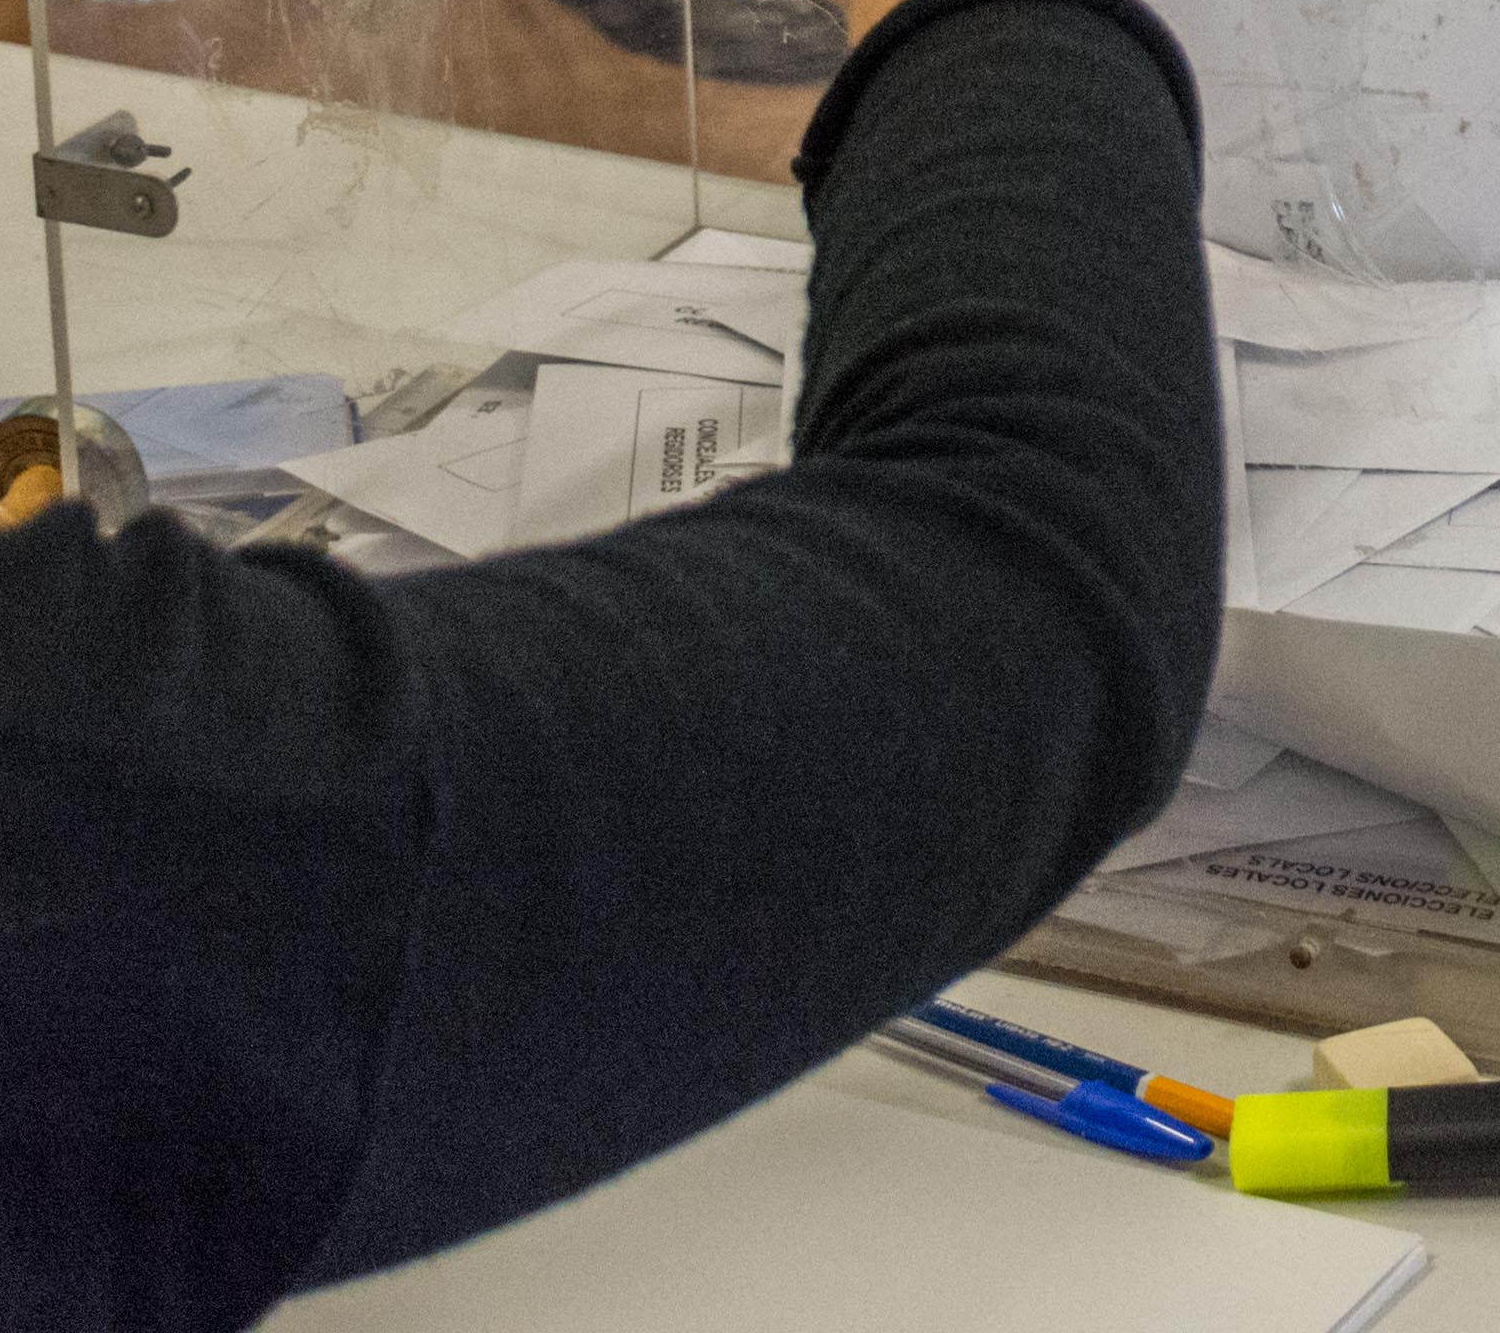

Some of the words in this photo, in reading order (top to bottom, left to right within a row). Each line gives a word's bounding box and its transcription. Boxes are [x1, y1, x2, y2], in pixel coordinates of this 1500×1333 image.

[1203, 863, 1325, 893] LOCALES
[1246, 854, 1350, 880] LOCALS
[1329, 884, 1495, 921] ELECCIONES
